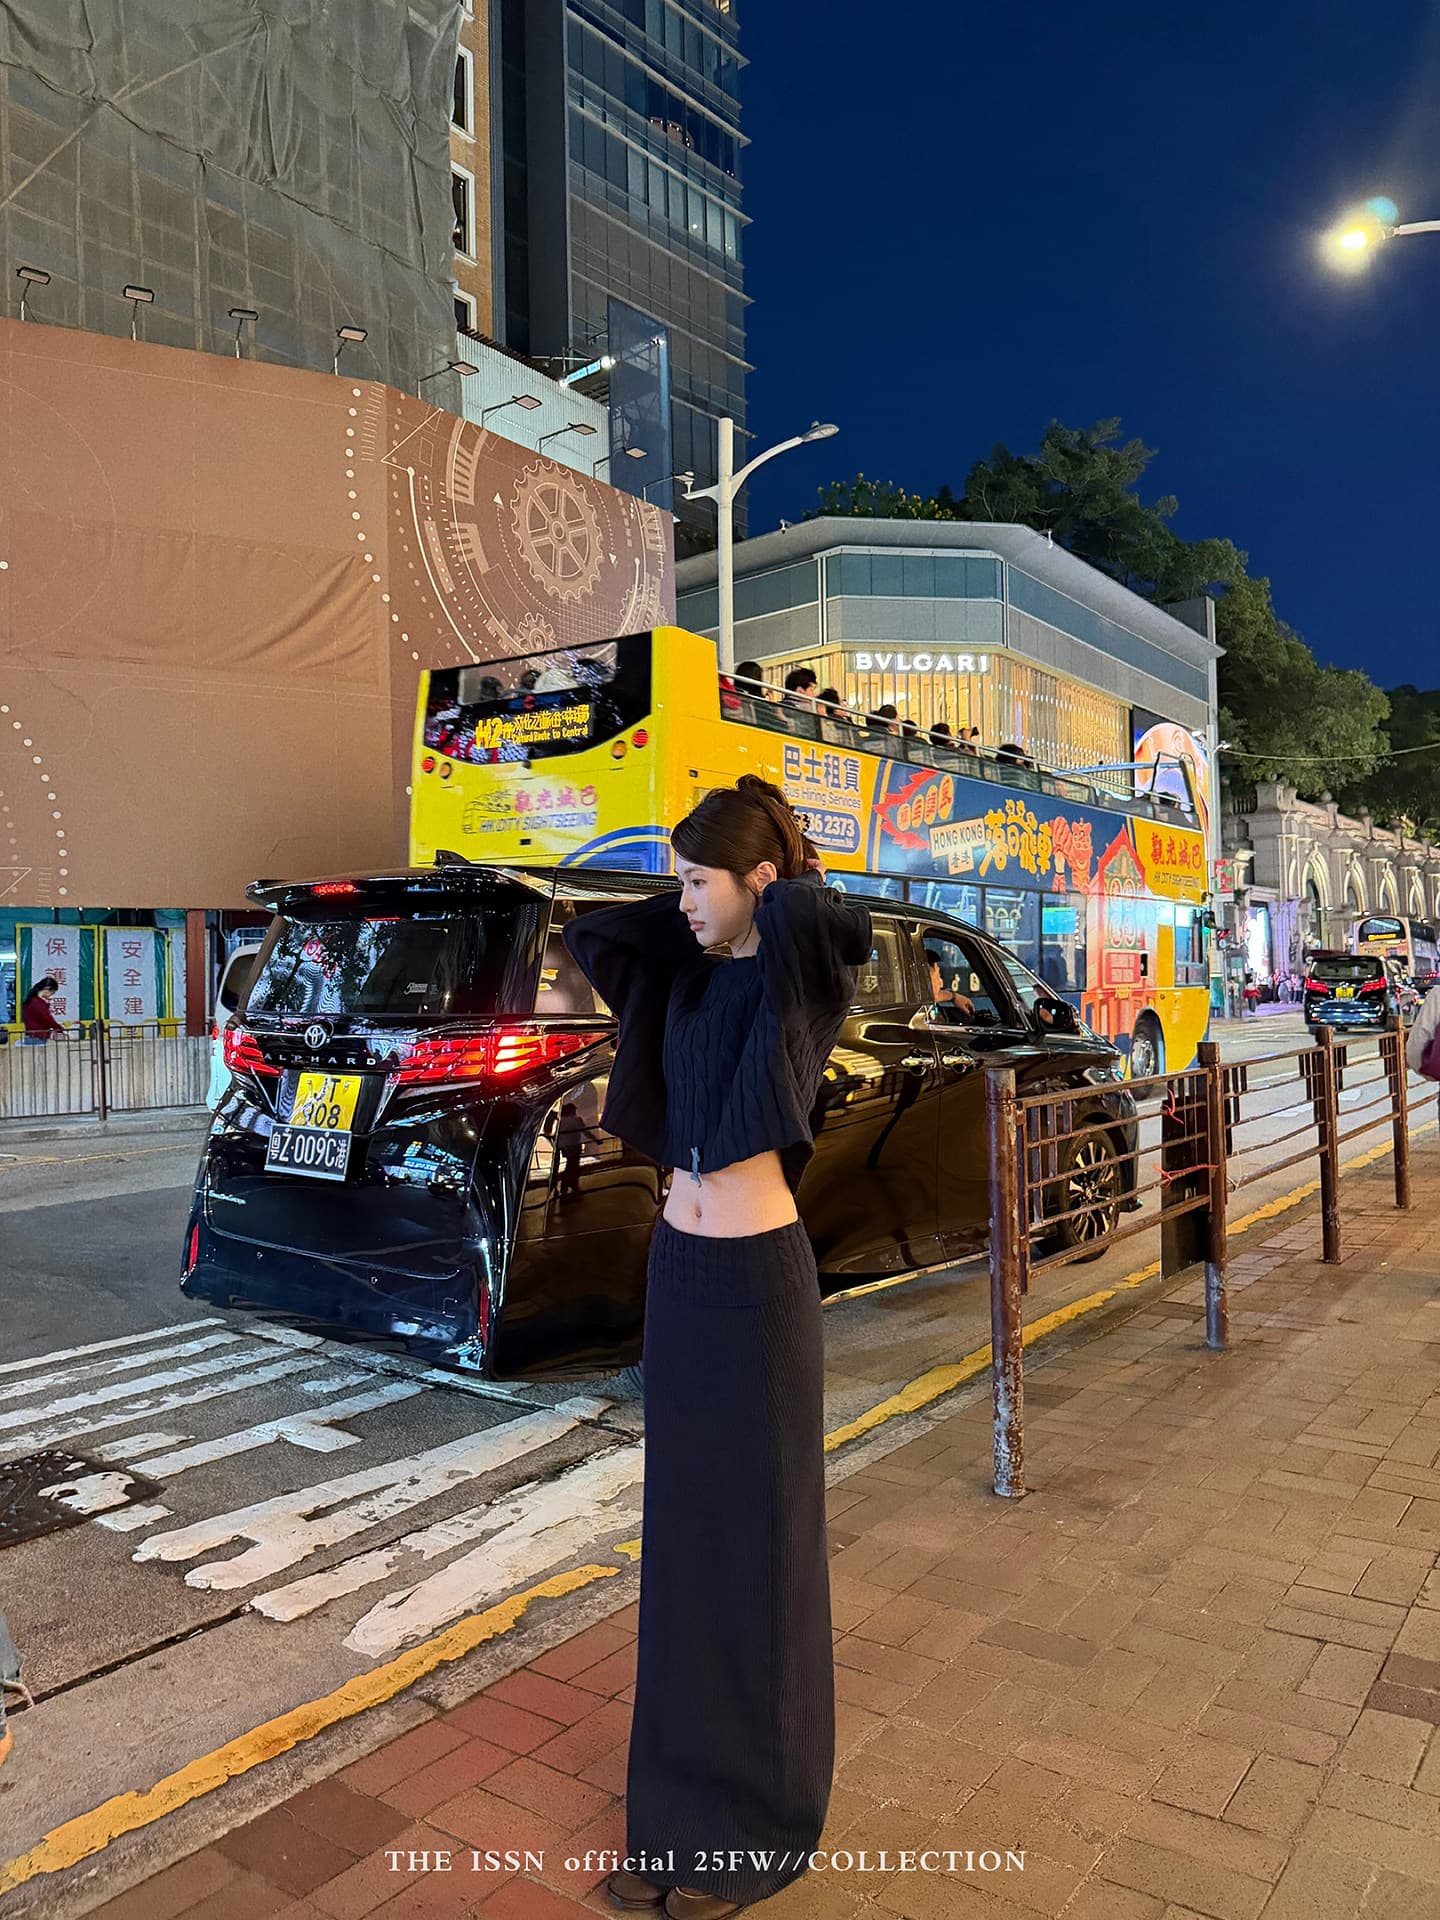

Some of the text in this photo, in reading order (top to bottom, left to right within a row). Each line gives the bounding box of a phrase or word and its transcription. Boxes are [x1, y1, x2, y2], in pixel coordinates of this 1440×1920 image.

[855, 653, 987, 672] BVLGARI
[552, 729, 561, 739] to
[562, 725, 588, 738] Central
[784, 745, 859, 792] 巴士租賃
[784, 784, 861, 808] Bus Hiring Services
[496, 816, 520, 832] CITY
[522, 811, 598, 830] SIGHTSEEING
[825, 815, 855, 837] 2373
[933, 824, 983, 850] HONG KONG
[45, 938, 67, 1040] 保護環
[264, 1053, 376, 1065] ALPHARD
